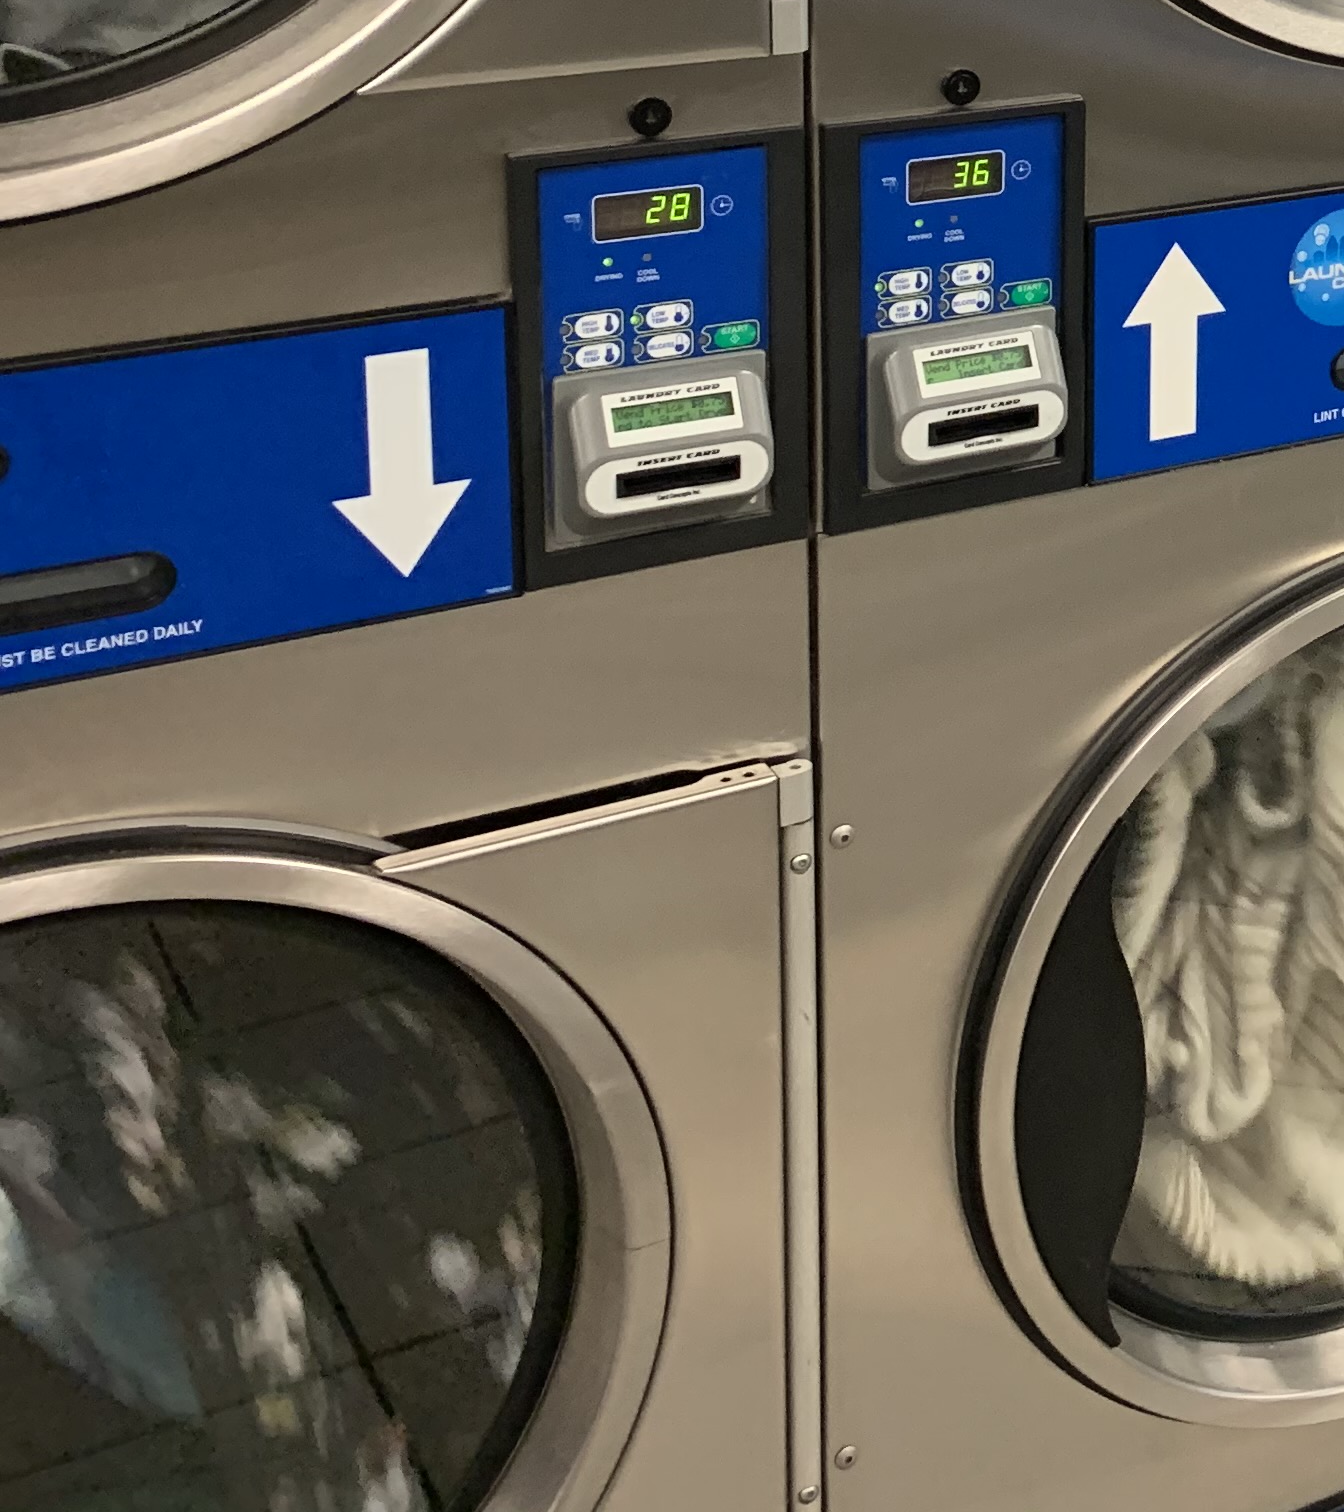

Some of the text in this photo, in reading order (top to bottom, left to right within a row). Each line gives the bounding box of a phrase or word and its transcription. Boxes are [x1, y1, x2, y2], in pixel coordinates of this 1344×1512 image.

[953, 159, 990, 188] 36
[645, 192, 691, 224] 28
[1017, 283, 1042, 293] START
[652, 310, 666, 318] LOW
[721, 324, 748, 335] START
[930, 337, 1018, 357] LAUNDRY CARD
[620, 383, 721, 404] LAUNDRY CARD
[947, 398, 1021, 417] INSERT CARD
[1313, 408, 1339, 423] LINT
[637, 448, 720, 467] INSERT CARD
[0, 619, 204, 668] ST BE CLEANED DAILY
